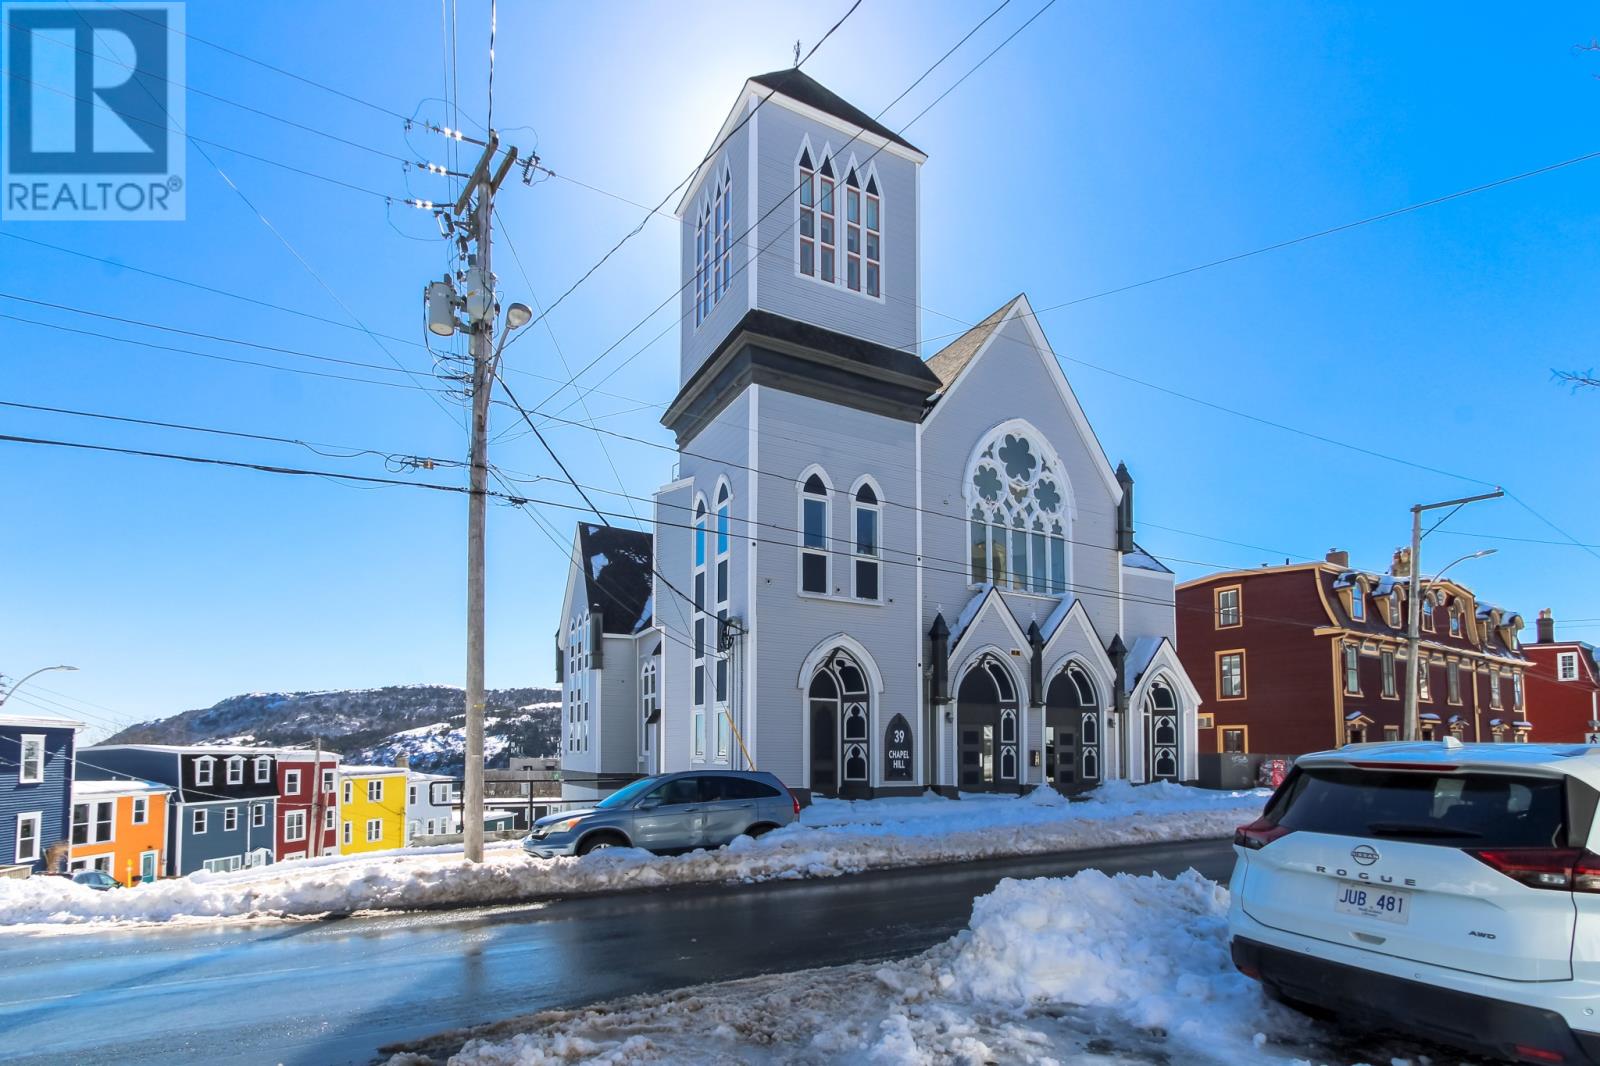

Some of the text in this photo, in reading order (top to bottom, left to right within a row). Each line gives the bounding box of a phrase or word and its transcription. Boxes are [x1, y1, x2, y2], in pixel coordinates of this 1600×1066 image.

[894, 730, 904, 743] 39
[888, 750, 909, 759] CHAPEL
[893, 760, 905, 769] HILL
[1316, 866, 1416, 886] ROGUE
[1339, 888, 1367, 906] JUB
[1376, 894, 1403, 913] 481
[1468, 930, 1496, 939] AWD
